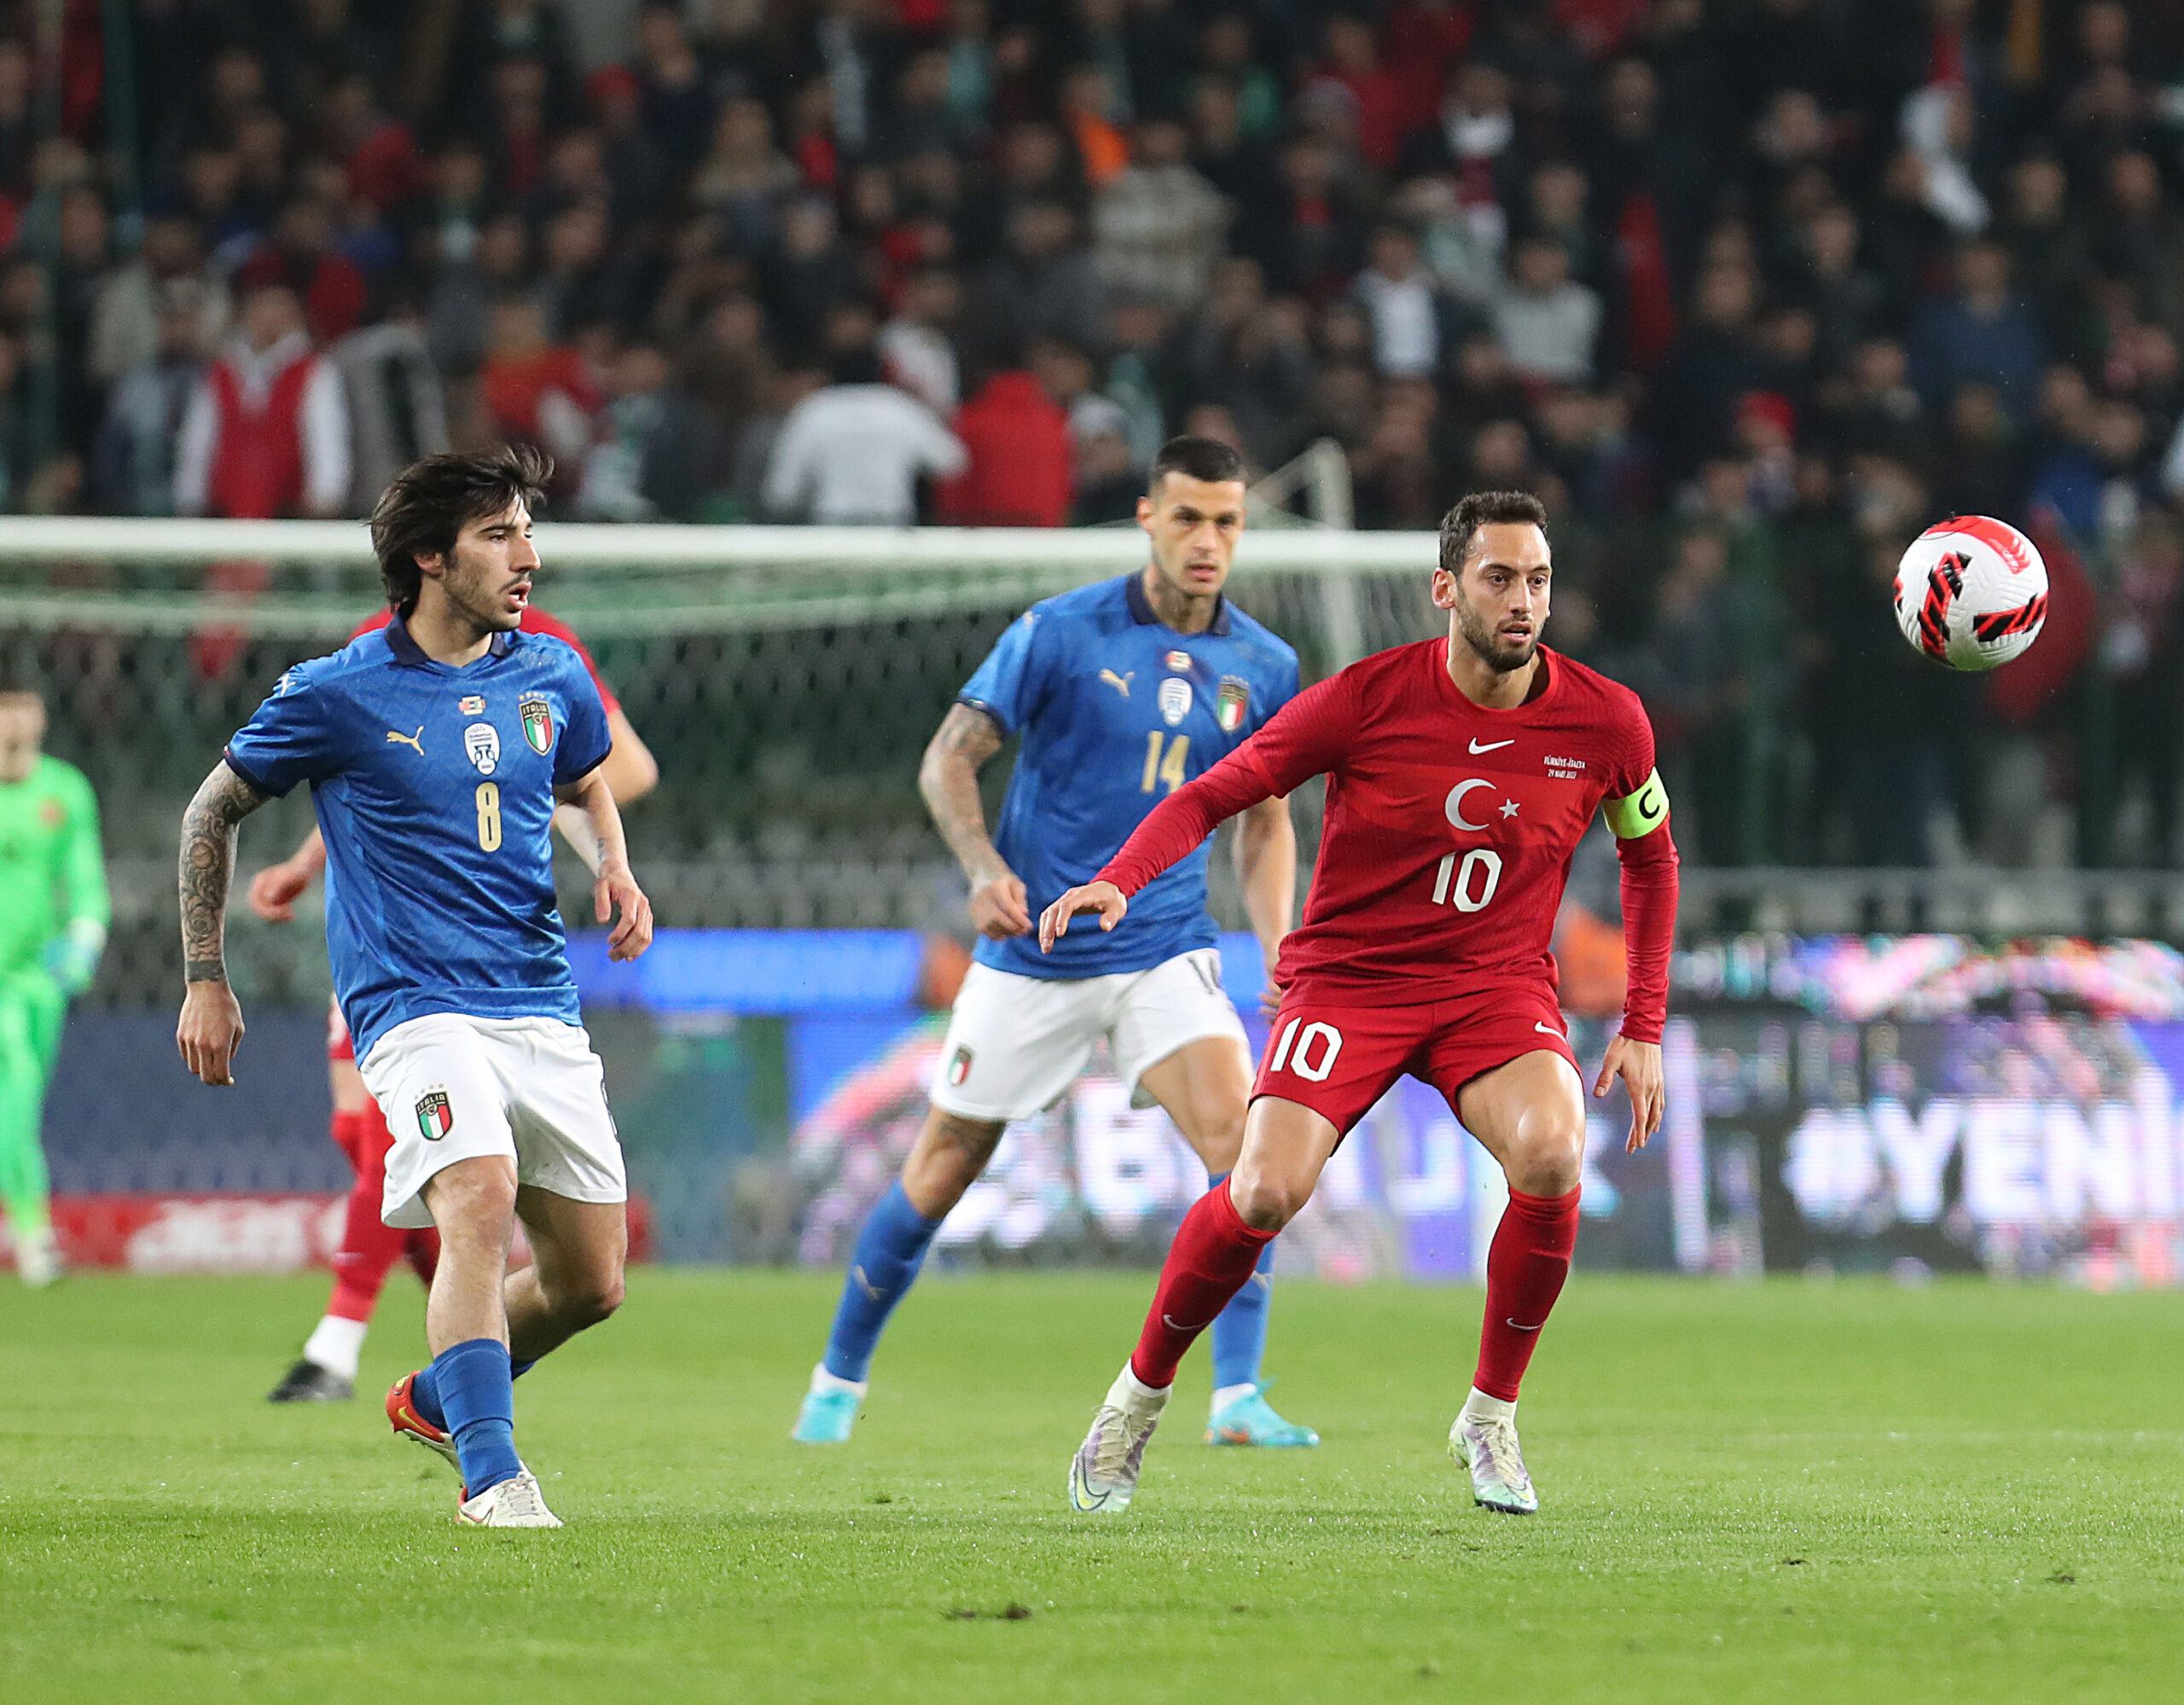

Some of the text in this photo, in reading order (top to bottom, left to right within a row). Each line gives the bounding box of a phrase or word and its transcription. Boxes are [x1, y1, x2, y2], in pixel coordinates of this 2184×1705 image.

[523, 704, 547, 715] ITALIA
[1141, 729, 1191, 794] 14
[475, 781, 502, 852] 8
[1639, 787, 1660, 819] C
[1432, 849, 1503, 913] 10
[1269, 1016, 1344, 1082] 10
[417, 1093, 446, 1111] ITALIA
